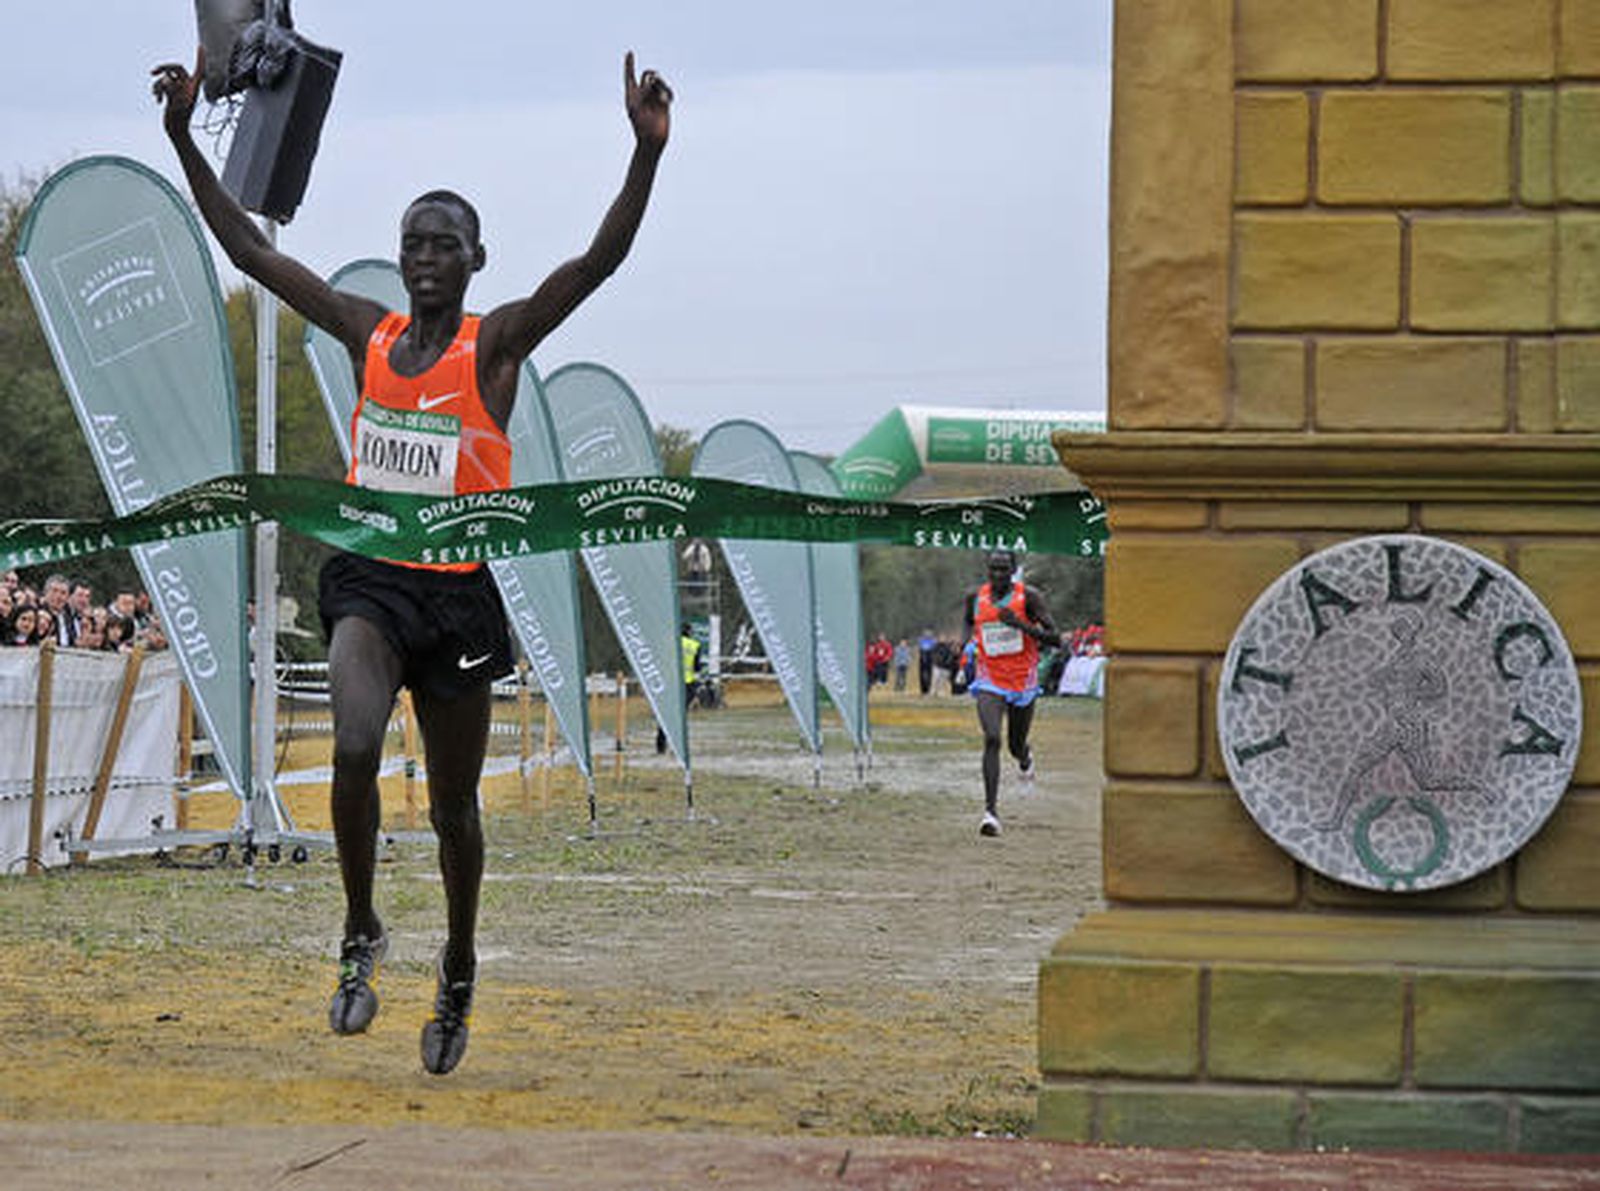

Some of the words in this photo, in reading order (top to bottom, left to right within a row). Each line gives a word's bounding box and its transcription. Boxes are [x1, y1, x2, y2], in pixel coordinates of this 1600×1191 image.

[986, 443, 1012, 462] DE
[577, 478, 696, 509] DIPUTACION
[417, 494, 535, 525] DIPUTACION
[624, 506, 646, 521] DE
[960, 510, 984, 525] DE
[466, 522, 488, 537] DE
[579, 524, 687, 547] SEVILLA
[914, 530, 1028, 551] SEVILLA
[6, 534, 114, 567] SEVILLA
[421, 539, 531, 564] SEVILLA
[1232, 545, 1566, 767] ITALICA
